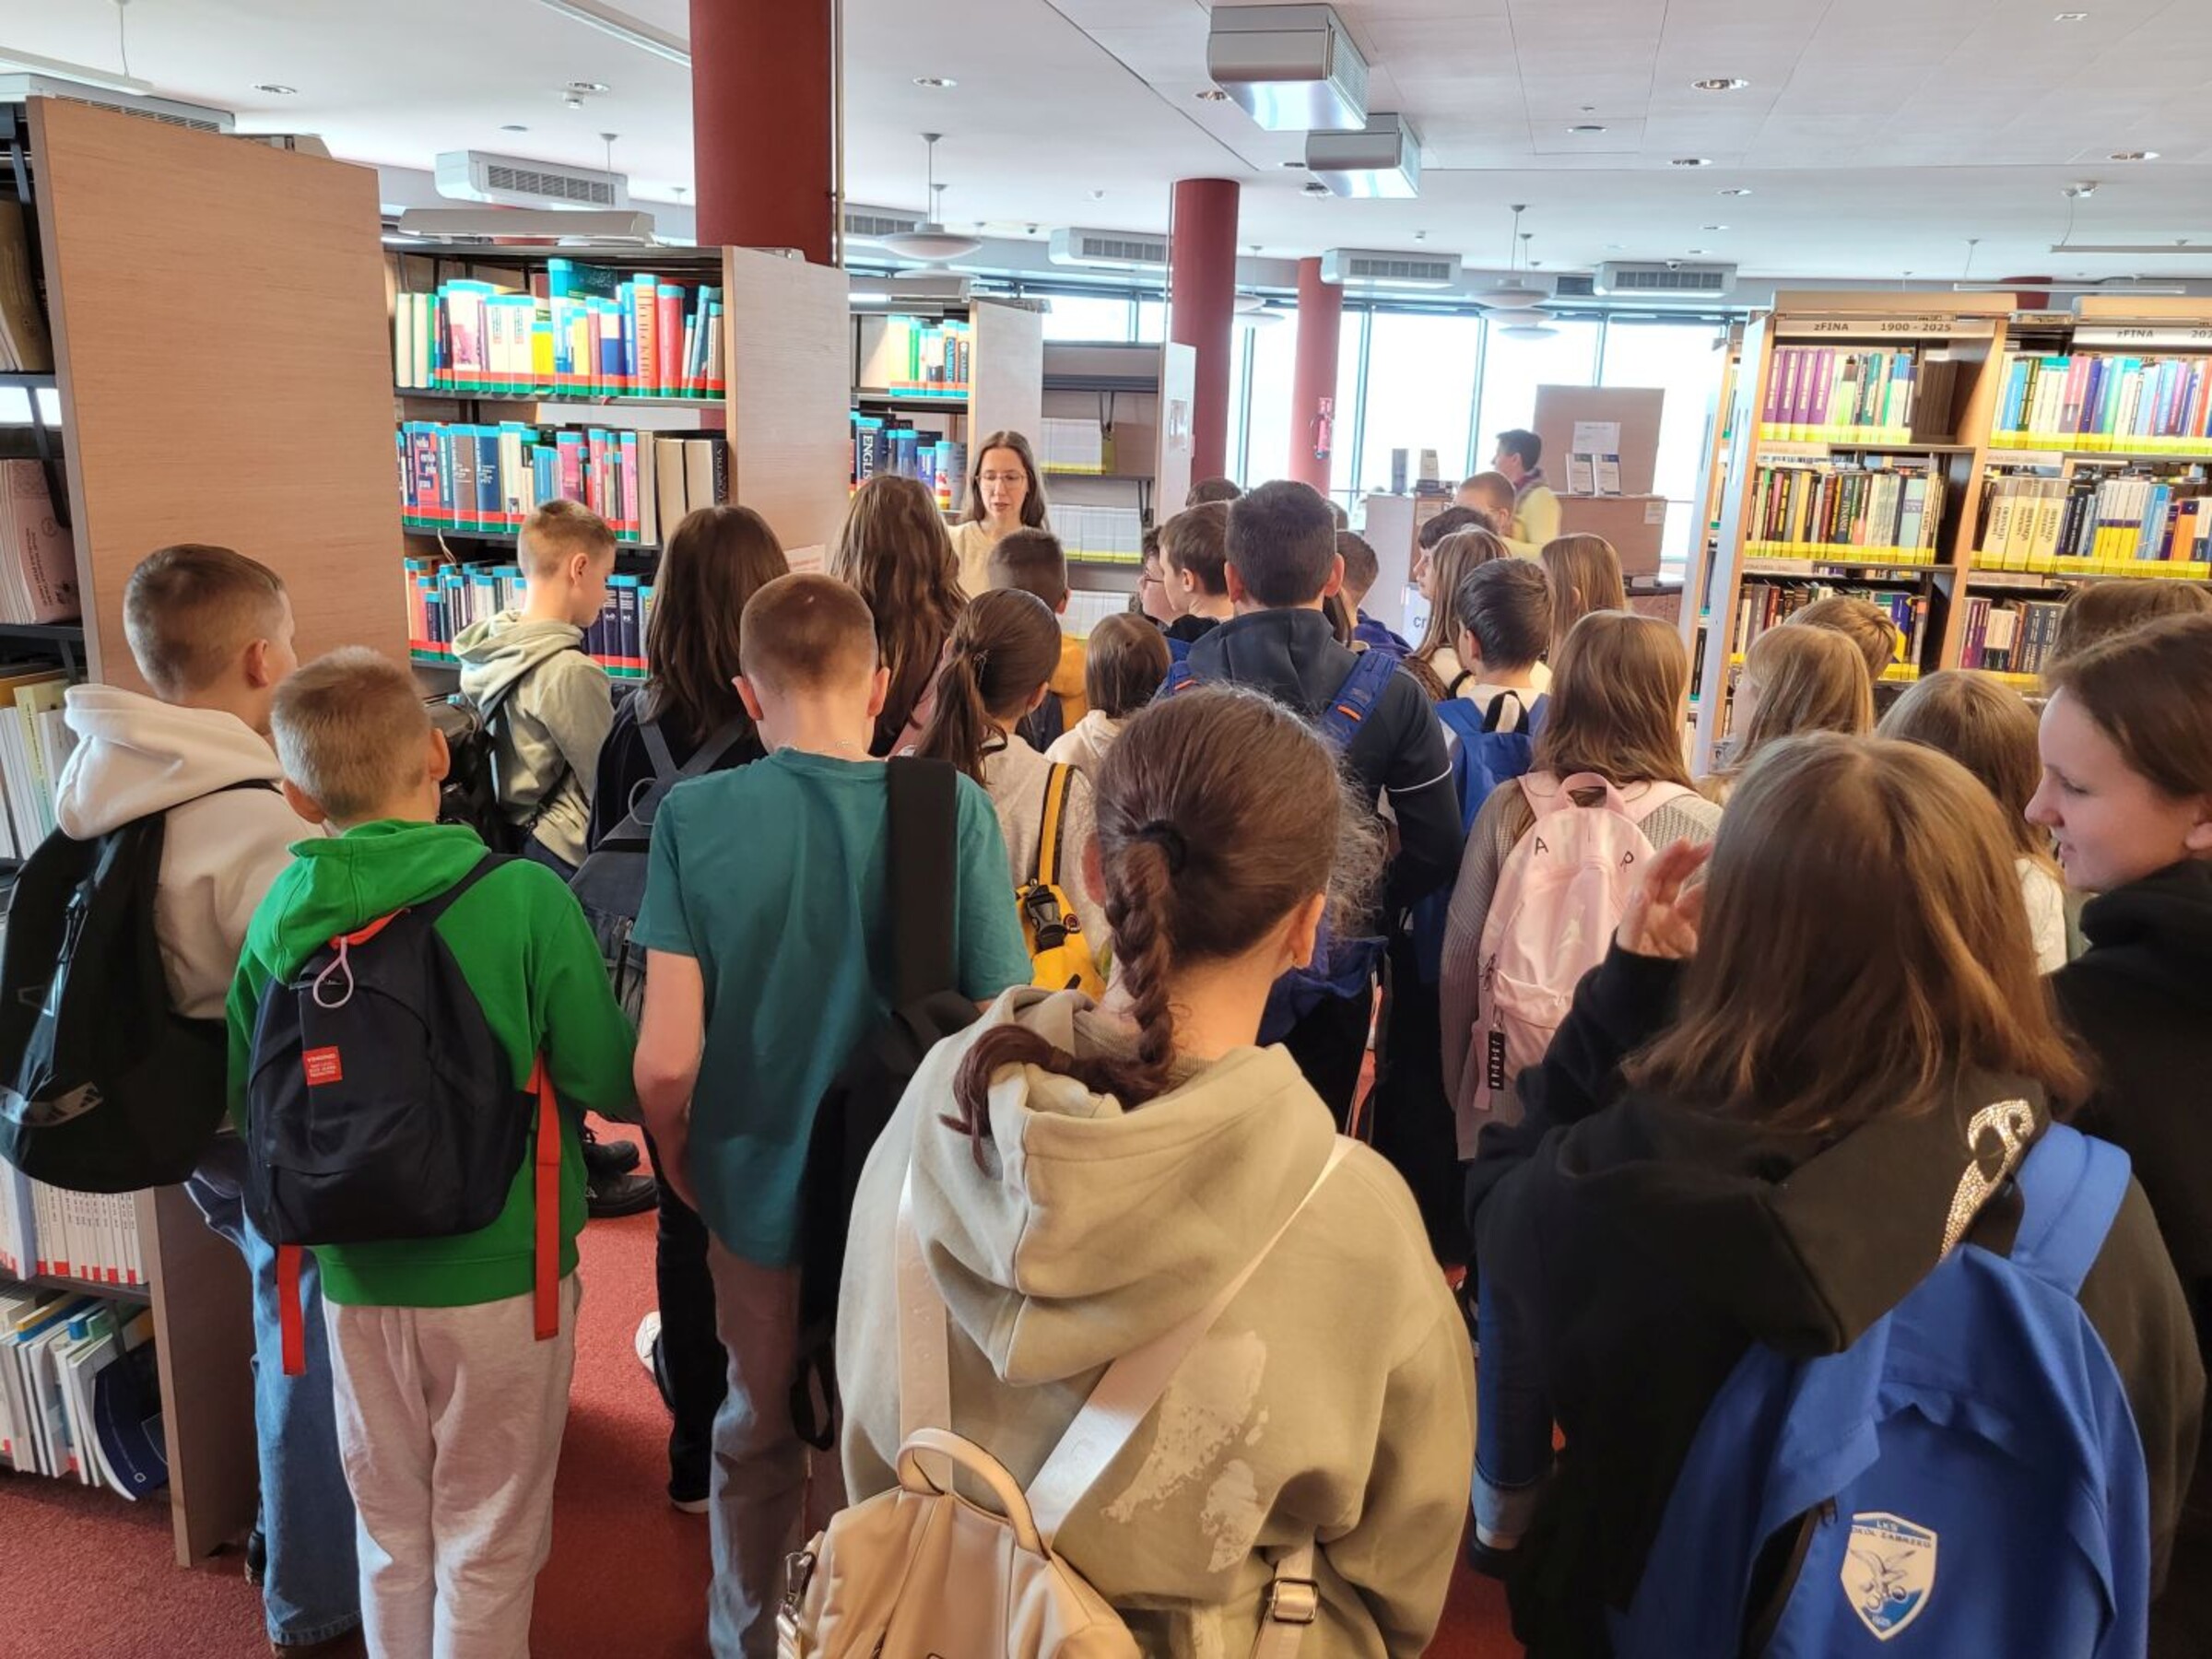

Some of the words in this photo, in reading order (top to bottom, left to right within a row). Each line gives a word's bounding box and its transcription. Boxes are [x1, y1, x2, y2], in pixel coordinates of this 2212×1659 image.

[1813, 323, 1849, 332] zFINA
[1881, 323, 1910, 332] 1900
[1923, 324, 1951, 332] 2025
[946, 338, 955, 382] CAMBRIDG
[863, 436, 874, 479] ENGLIS
[1535, 836, 1548, 855] A
